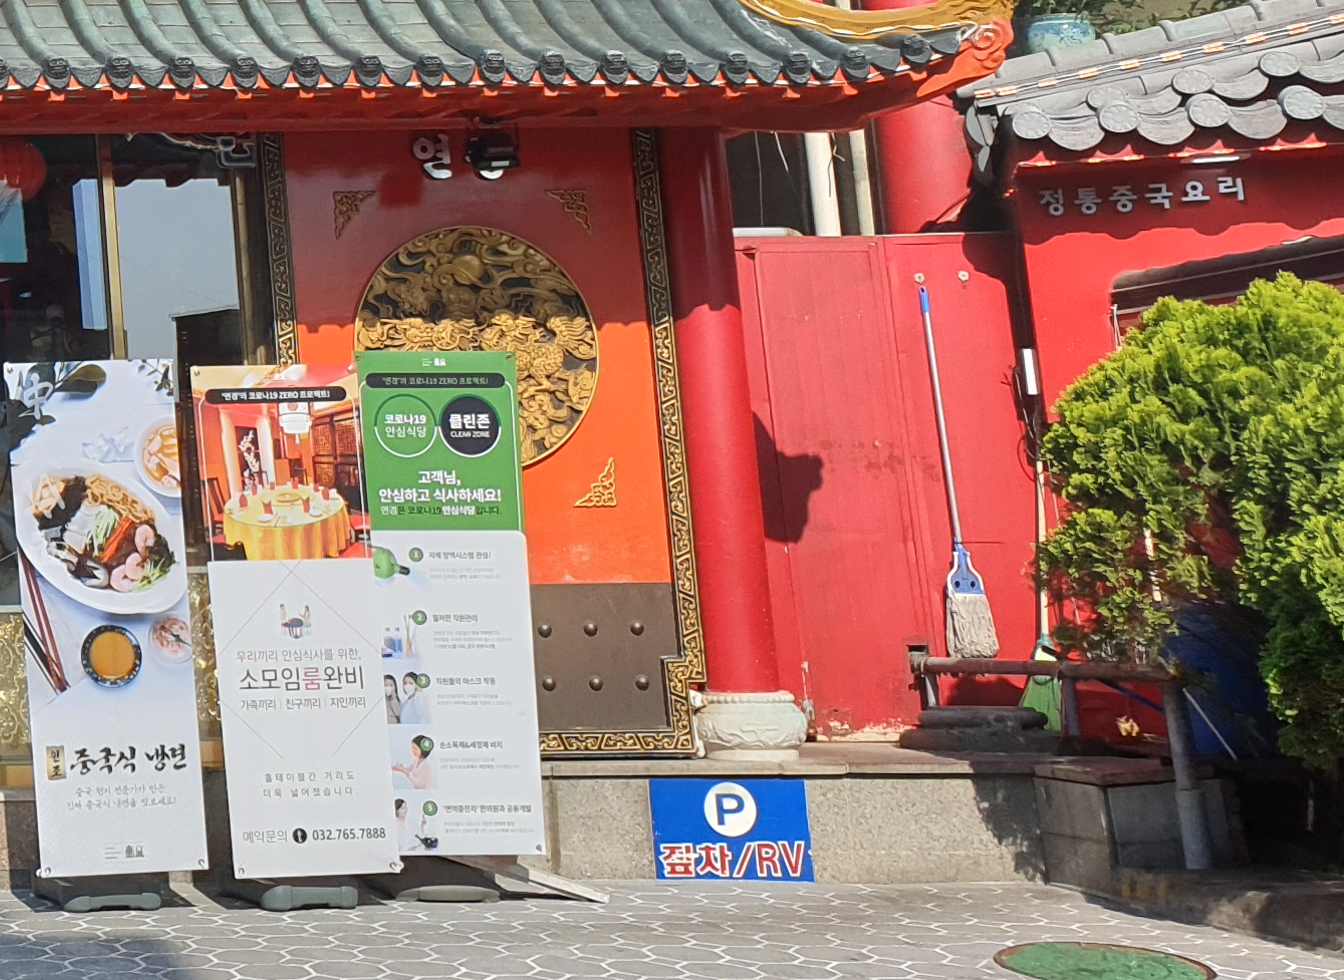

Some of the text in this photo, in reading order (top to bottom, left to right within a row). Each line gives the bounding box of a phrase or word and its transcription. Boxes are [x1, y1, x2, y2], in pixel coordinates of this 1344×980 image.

[413, 133, 504, 180] 연
[1039, 176, 1246, 217] 정통중국요리
[383, 413, 427, 425] 코로나19
[449, 413, 491, 429] 클린존
[384, 425, 427, 438] 안심식당
[450, 430, 472, 438] CLEAN
[417, 469, 462, 486] 고객님,
[378, 487, 502, 503] 안심하고 식사하세요!
[236, 648, 362, 663] 우리끼리 안심식사를 위한,
[239, 665, 364, 691] 소모임룸완비
[240, 696, 366, 711] 가족끼리 친구끼리 지인끼리
[49, 750, 62, 778] 원조
[70, 743, 187, 775] 중국식 냉면
[324, 770, 355, 781] 거리도
[263, 788, 283, 798] 더욱
[715, 793, 745, 826] P
[242, 827, 386, 843] 예약문의 032.765.7888
